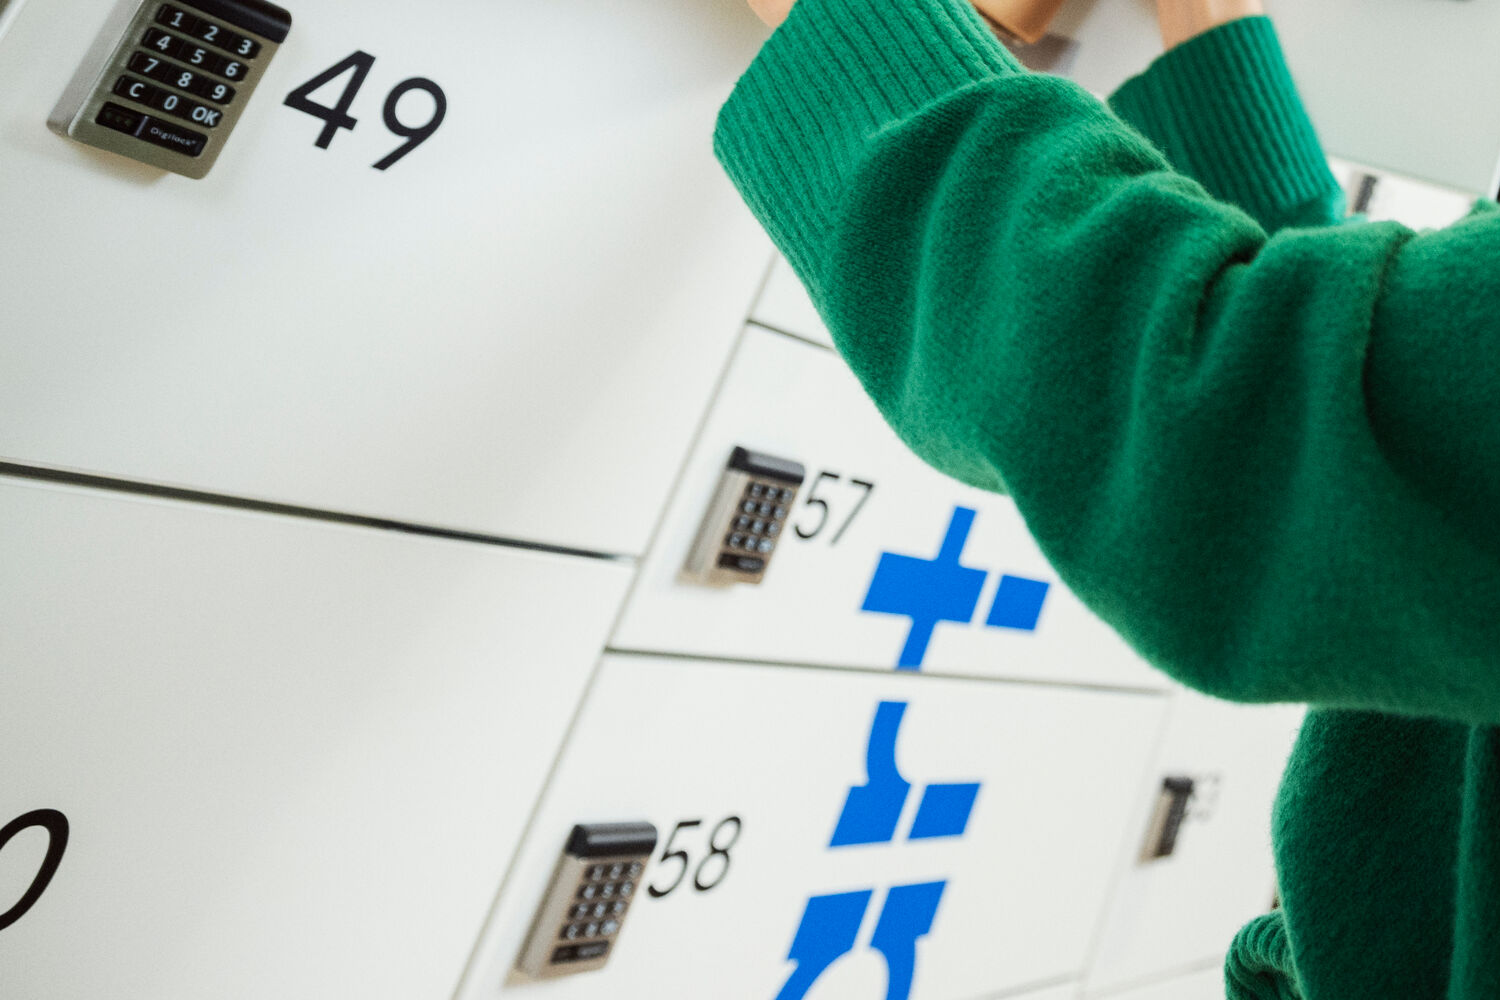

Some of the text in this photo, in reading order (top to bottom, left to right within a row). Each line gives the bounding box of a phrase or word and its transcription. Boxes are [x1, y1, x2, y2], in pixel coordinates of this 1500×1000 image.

[170, 12, 252, 55] 1 2 3
[156, 35, 240, 77] 4 5 6
[143, 58, 227, 100] 7 8 9
[129, 82, 219, 126] C 0 OK
[283, 50, 447, 171] 49
[793, 471, 876, 546] 57
[647, 815, 742, 898] 58
